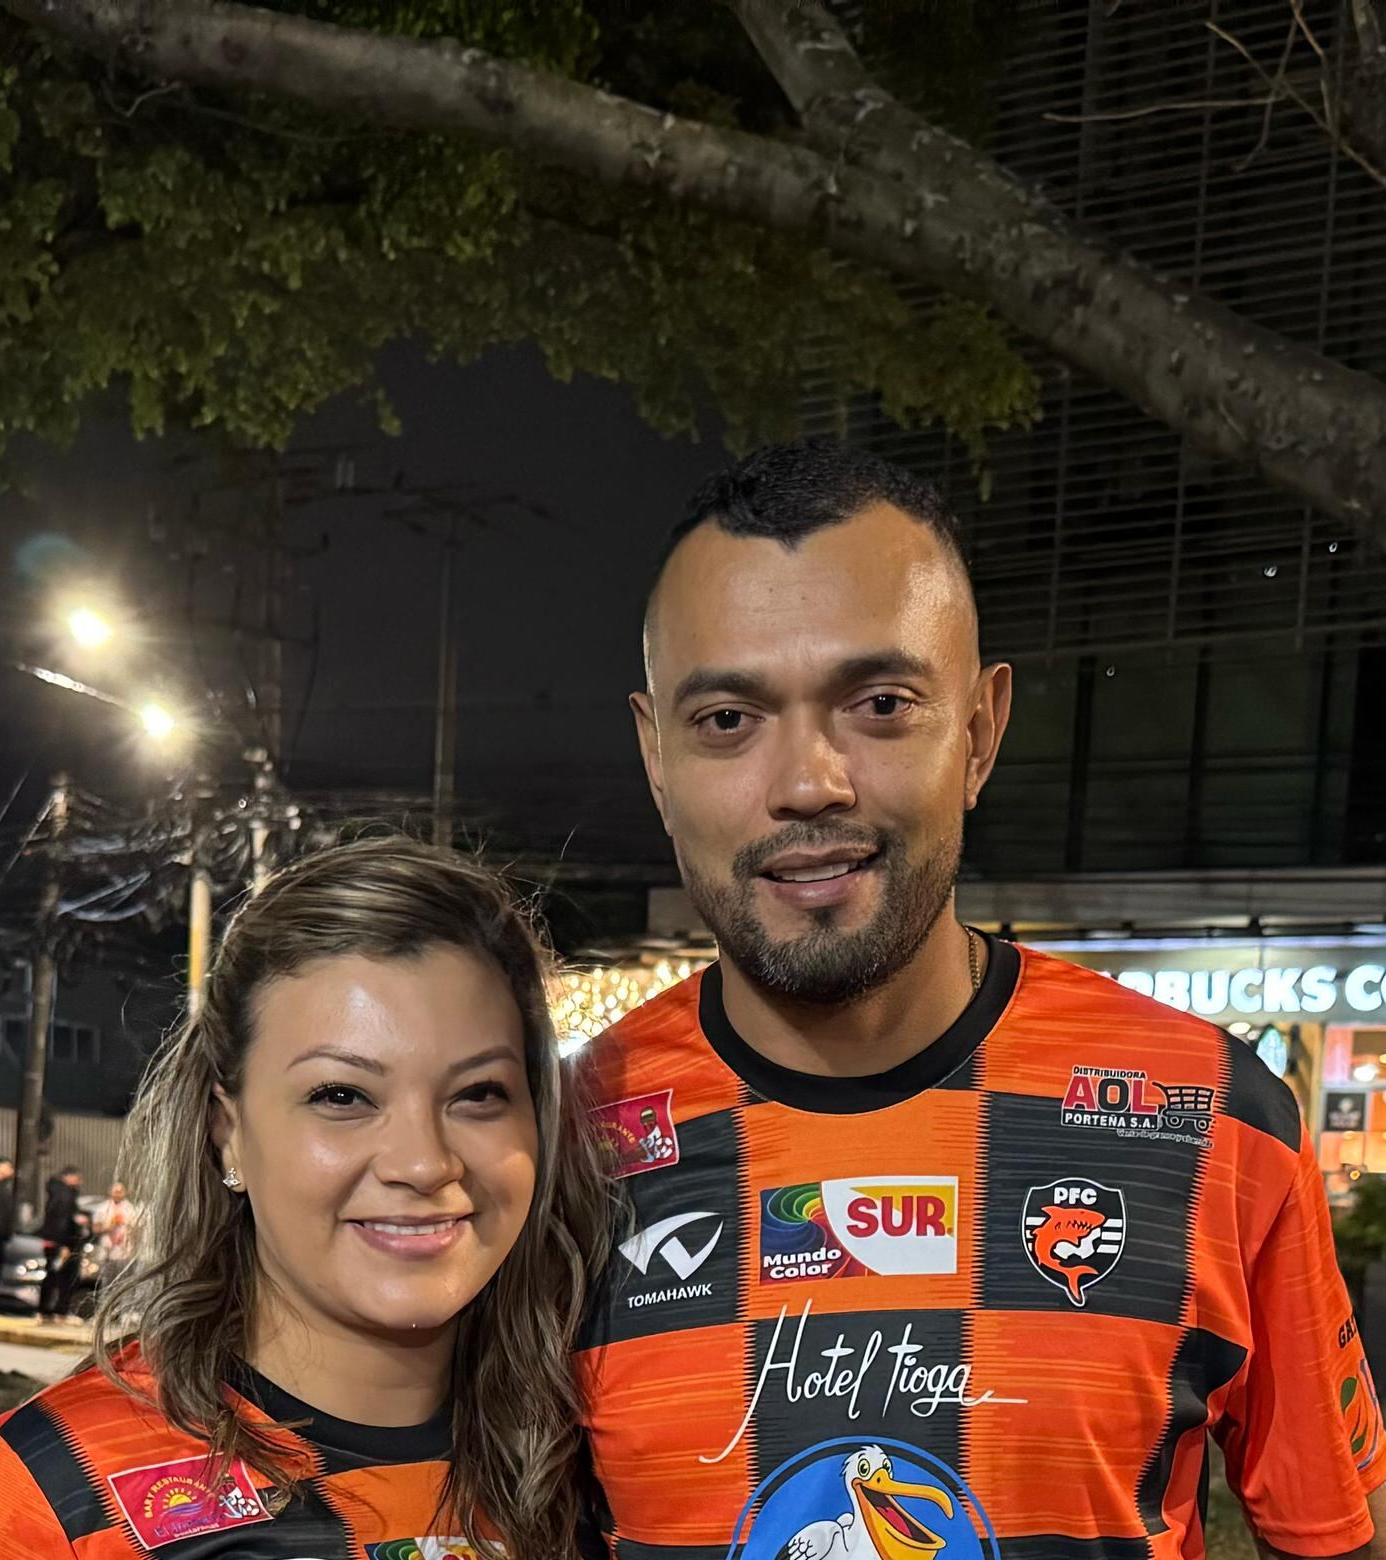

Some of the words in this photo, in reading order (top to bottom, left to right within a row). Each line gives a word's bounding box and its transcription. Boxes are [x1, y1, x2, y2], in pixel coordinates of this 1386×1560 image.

[1073, 1066, 1146, 1079] DISTRIBUIDORA
[1064, 1076, 1157, 1113] AOL
[1065, 1112, 1126, 1127] PORTEÑA
[1130, 1118, 1156, 1129] S.A.
[1053, 1187, 1097, 1205] PFC
[846, 1195, 946, 1238] SUR
[763, 1247, 842, 1267] Mundo
[769, 1262, 832, 1279] Color
[628, 1283, 712, 1308] TOMAHAWK
[697, 1299, 881, 1464] Hotel
